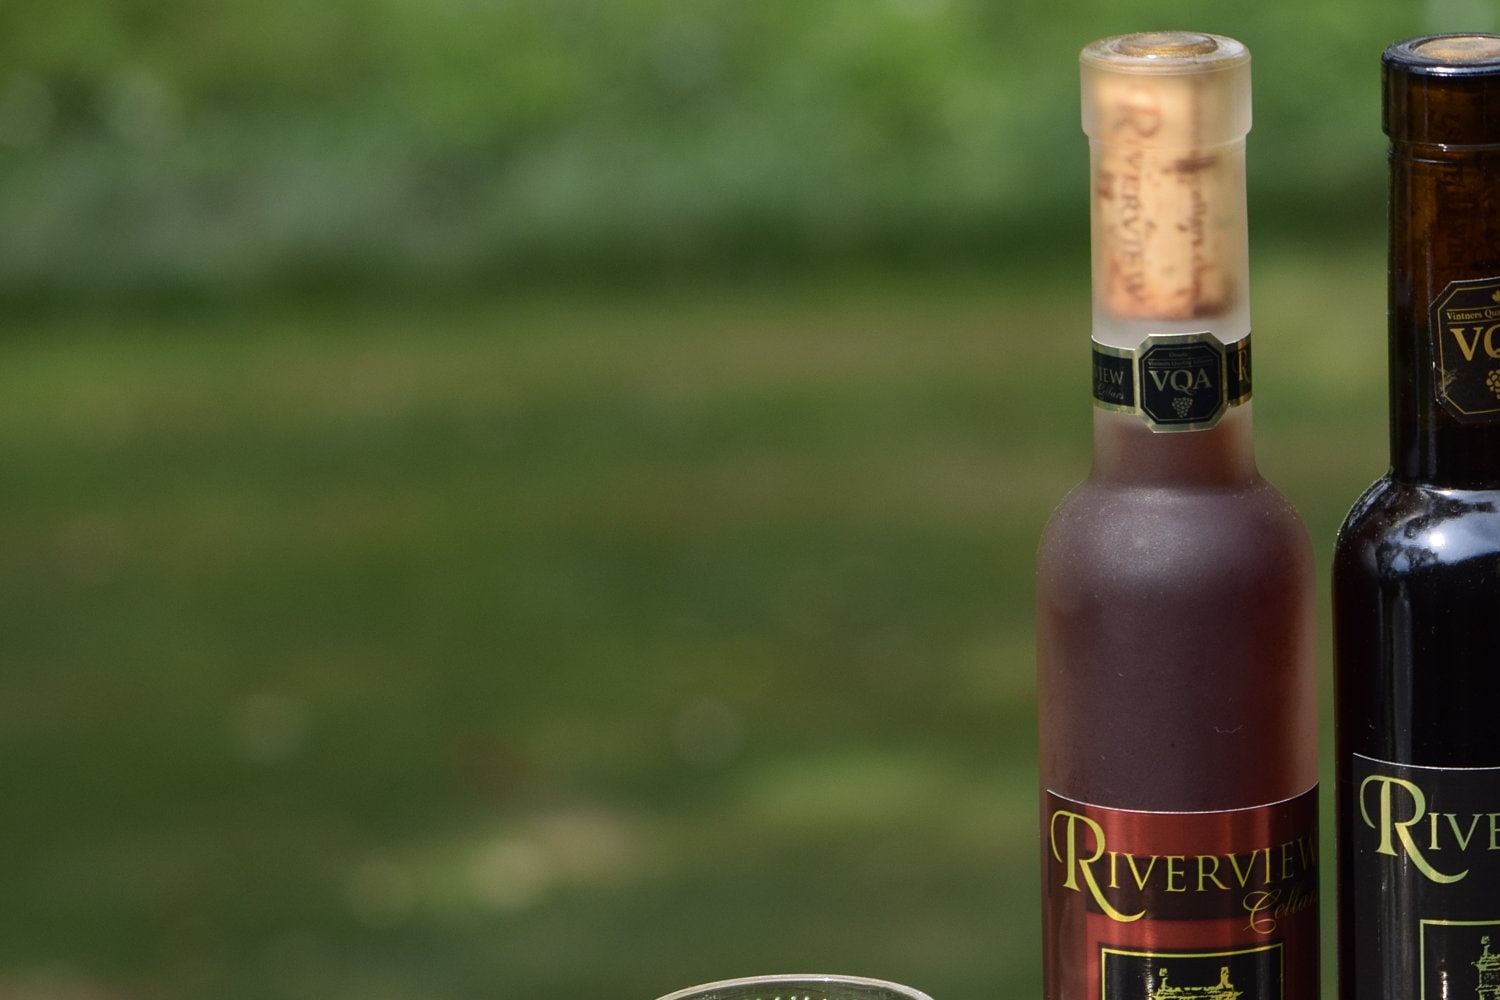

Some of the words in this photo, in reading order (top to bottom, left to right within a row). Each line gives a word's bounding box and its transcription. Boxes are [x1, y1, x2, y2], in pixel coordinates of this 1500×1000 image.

[1446, 310, 1482, 321] Vintners
[1096, 366, 1124, 385] IEW
[1148, 367, 1212, 396] VQA
